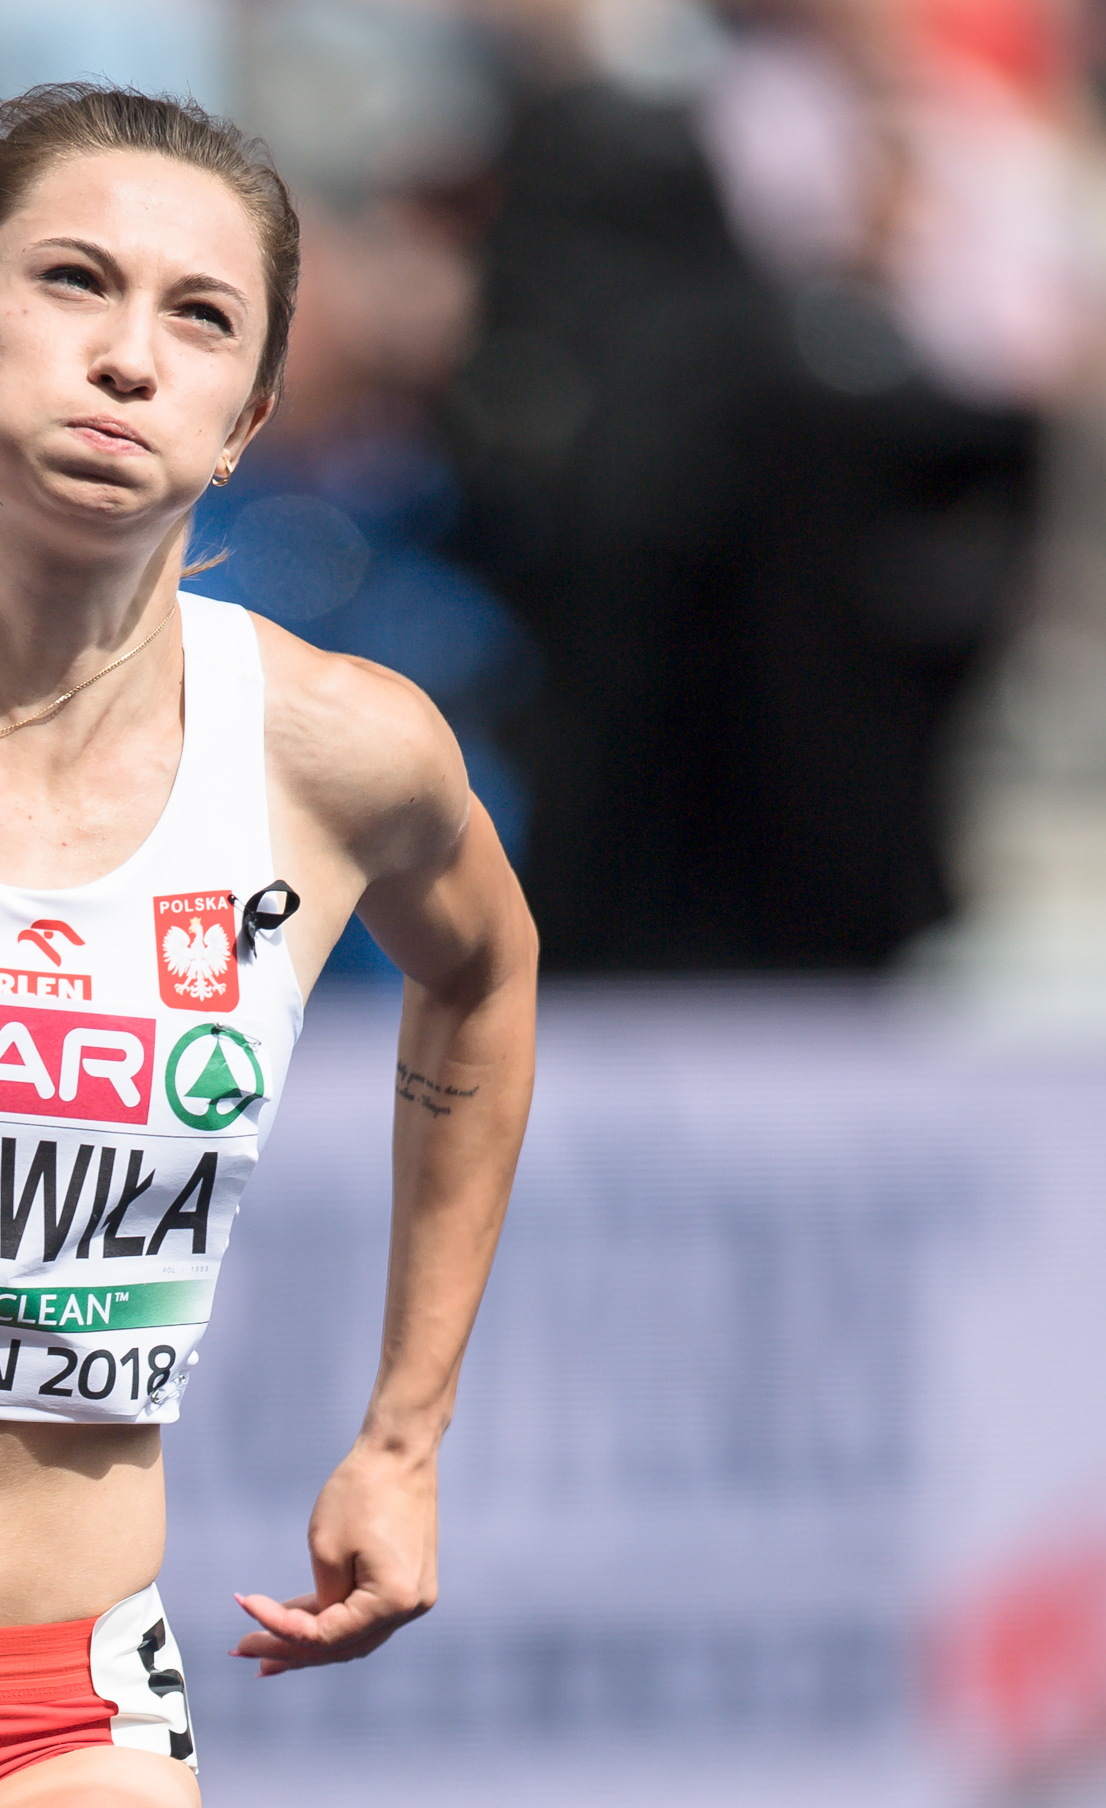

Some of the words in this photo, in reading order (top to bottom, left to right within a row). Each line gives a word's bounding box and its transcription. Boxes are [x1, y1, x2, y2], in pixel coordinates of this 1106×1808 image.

[159, 895, 229, 915] POLSKA
[162, 1266, 176, 1274] POL
[38, 1344, 177, 1401] 2018
